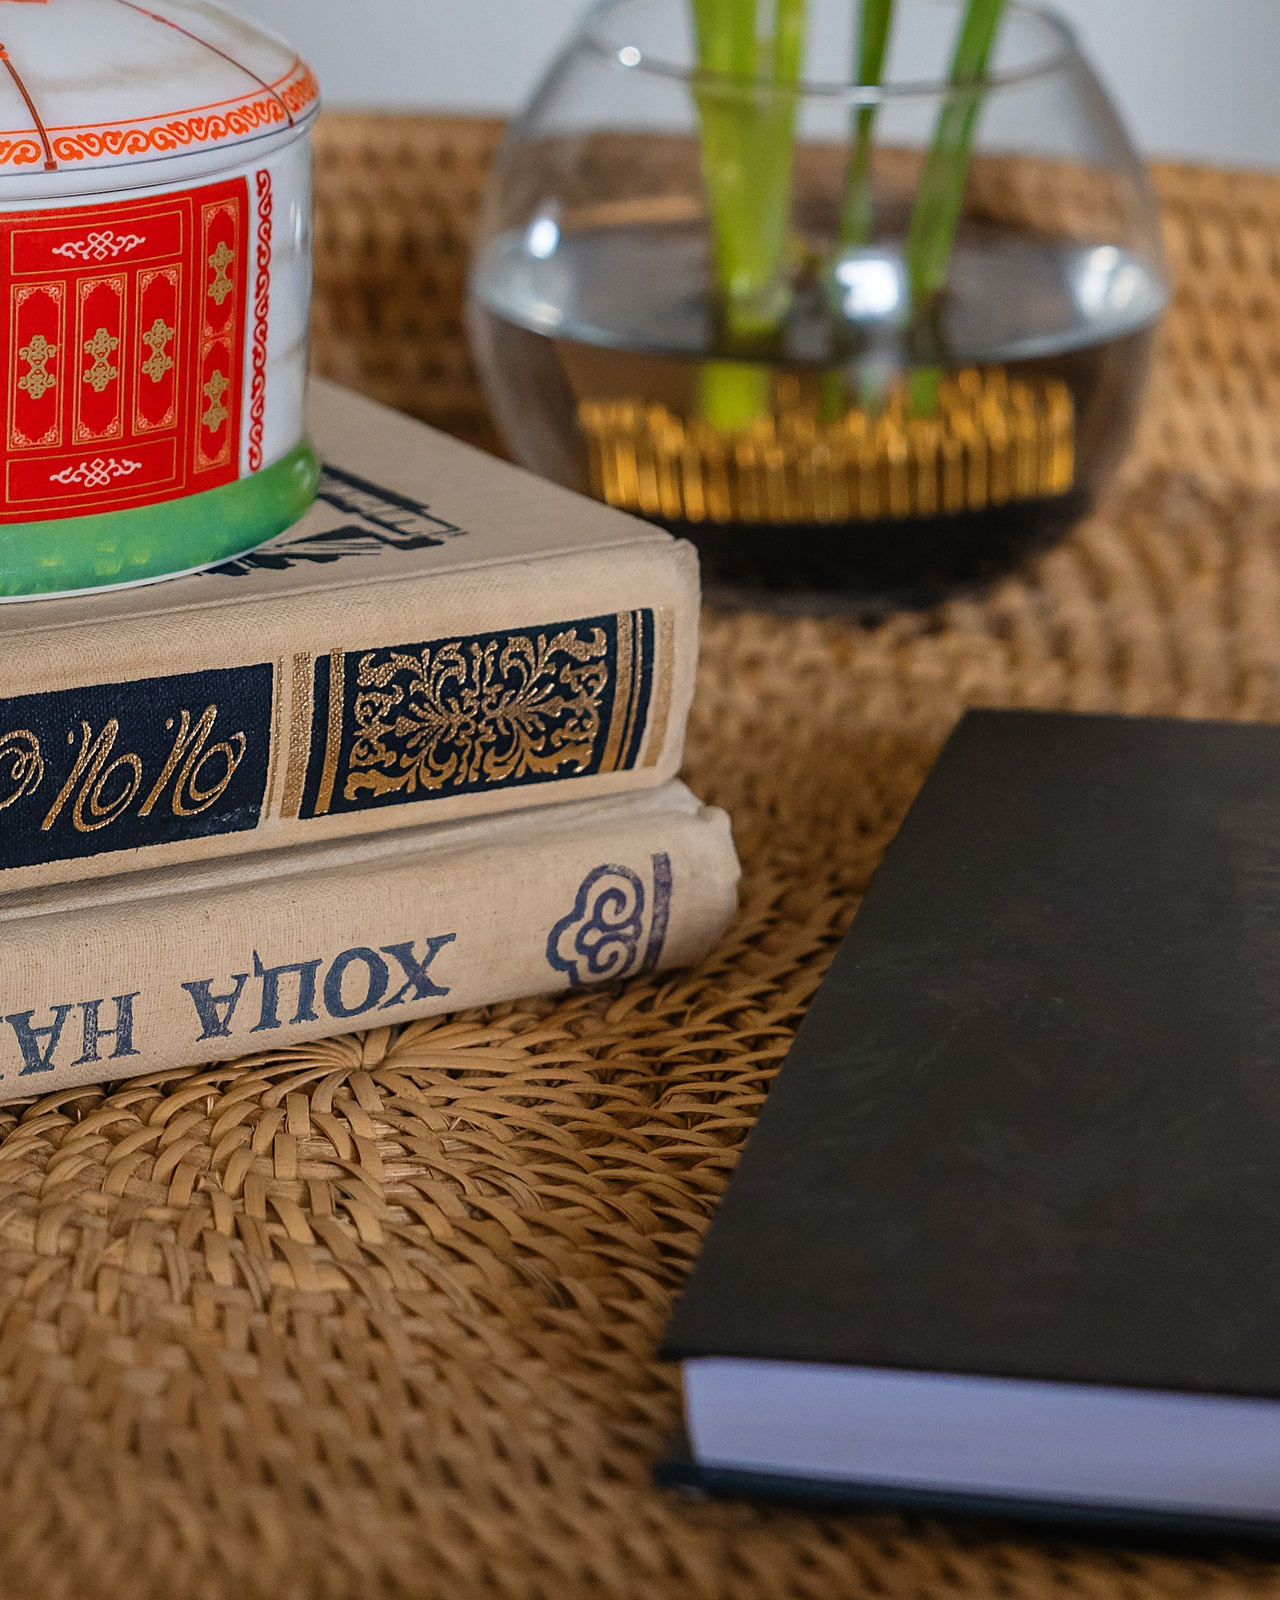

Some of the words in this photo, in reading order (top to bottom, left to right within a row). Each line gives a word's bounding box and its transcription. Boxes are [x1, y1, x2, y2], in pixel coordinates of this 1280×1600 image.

[41, 717, 141, 832] И.
[138, 703, 246, 816] И.
[181, 932, 456, 1039] ХОЦА
